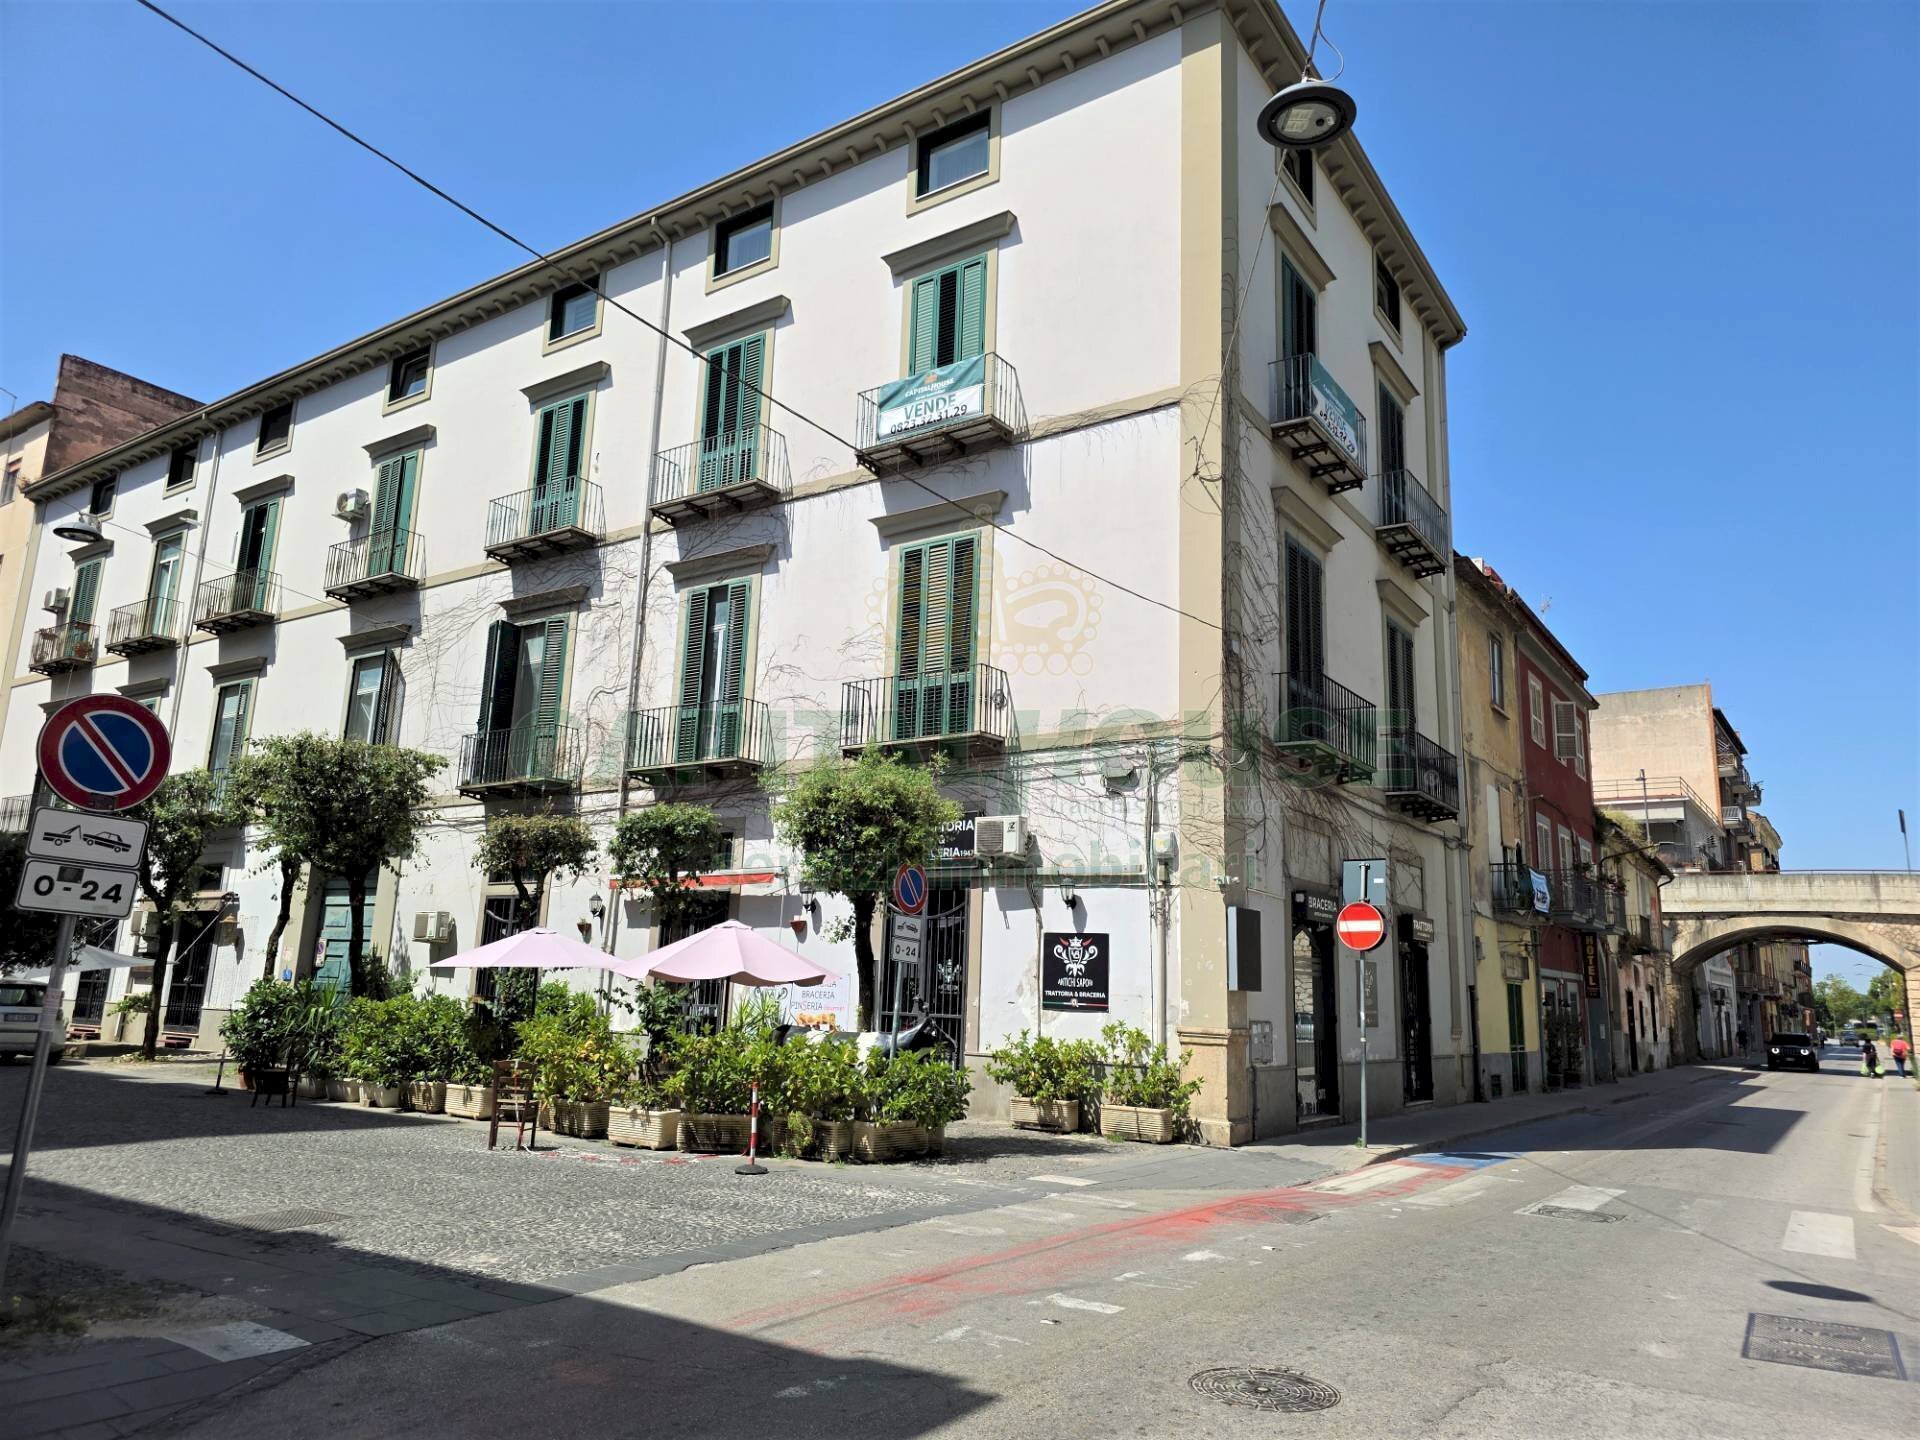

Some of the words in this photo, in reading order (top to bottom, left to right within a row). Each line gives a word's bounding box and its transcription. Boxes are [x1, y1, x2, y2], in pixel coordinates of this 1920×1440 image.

[904, 394, 956, 420] VENDE
[1308, 896, 1338, 912] BRACERIA
[1585, 936, 1597, 986] HOTEL
[801, 990, 836, 999] BRACERIA
[1044, 990, 1074, 998] TRATTORIA
[791, 1001, 823, 1011] PINSERIA
